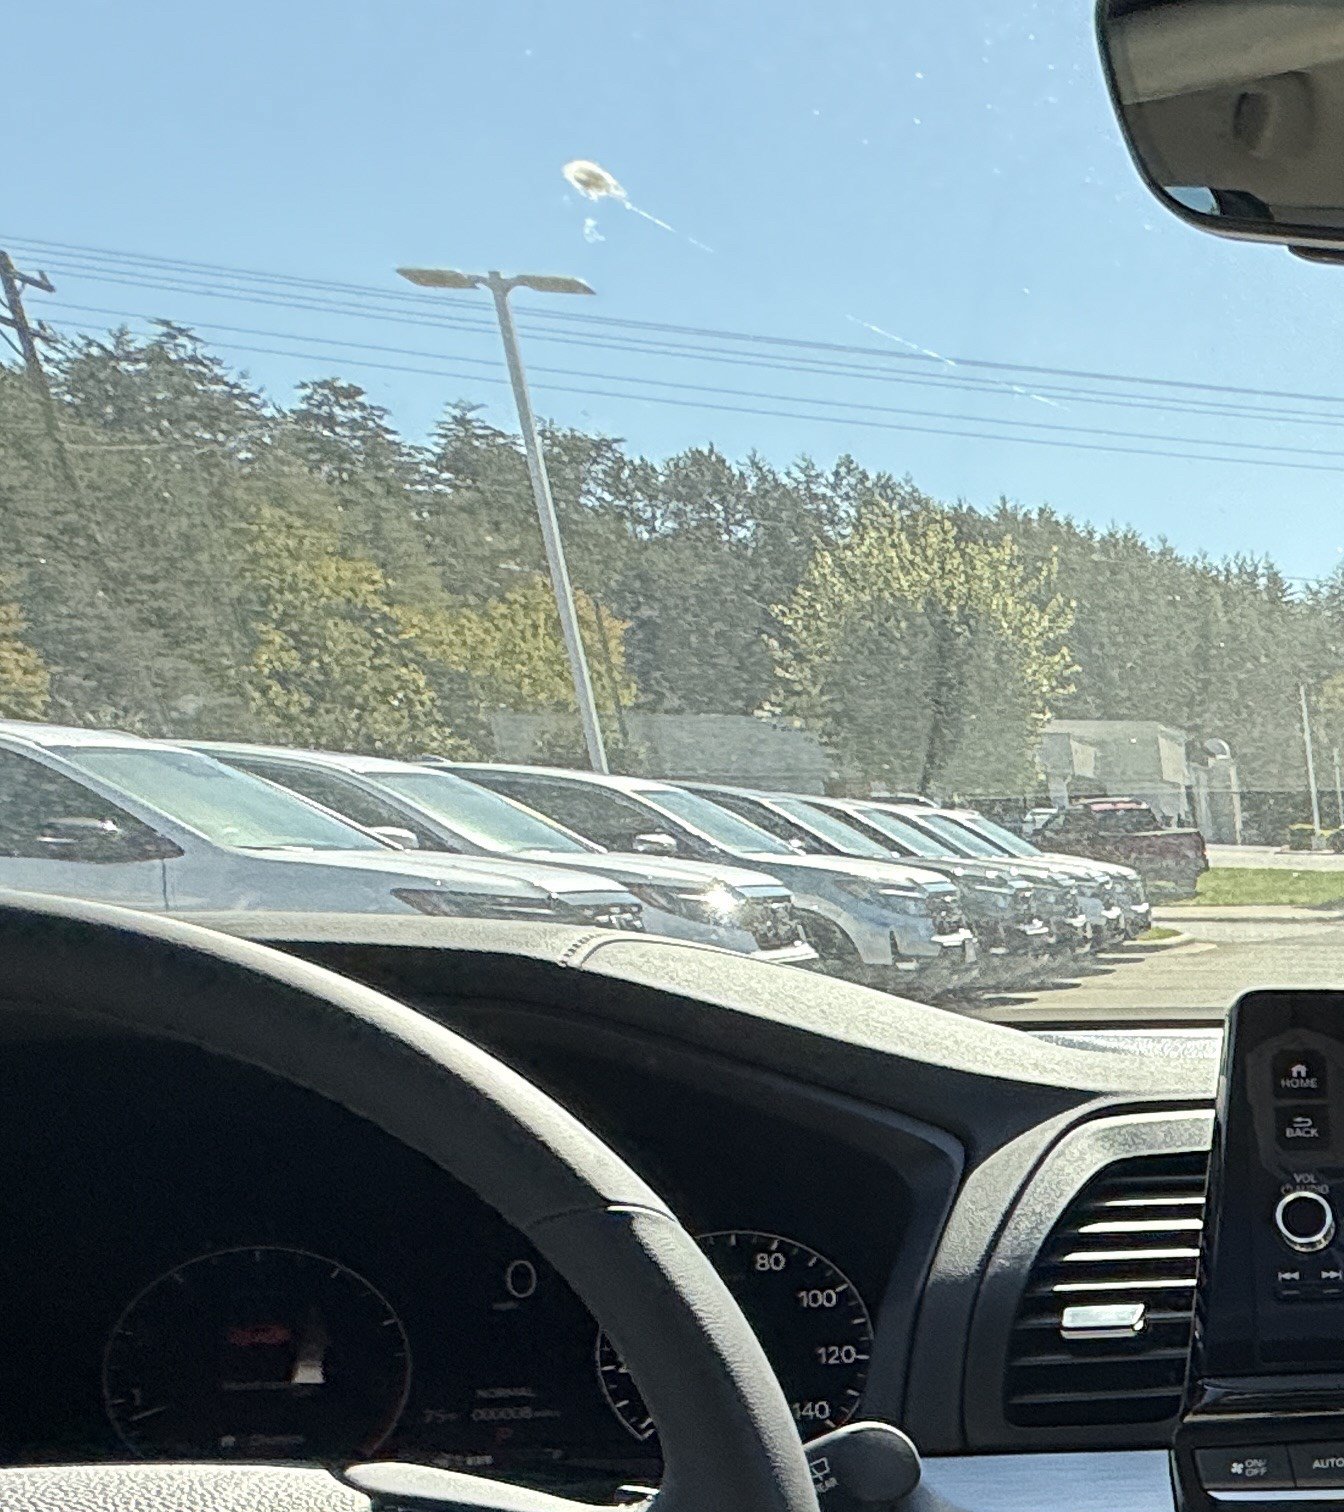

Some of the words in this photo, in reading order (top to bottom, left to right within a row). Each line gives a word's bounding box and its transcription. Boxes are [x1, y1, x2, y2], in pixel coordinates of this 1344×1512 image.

[1281, 1078, 1318, 1089] HOME
[1285, 1127, 1319, 1138] BACK
[1293, 1172, 1317, 1184] VOL
[755, 1252, 786, 1272] 80
[506, 1260, 537, 1298] 0
[797, 1288, 837, 1309] 100
[817, 1345, 857, 1364] 120
[1244, 1467, 1268, 1477] OFF
